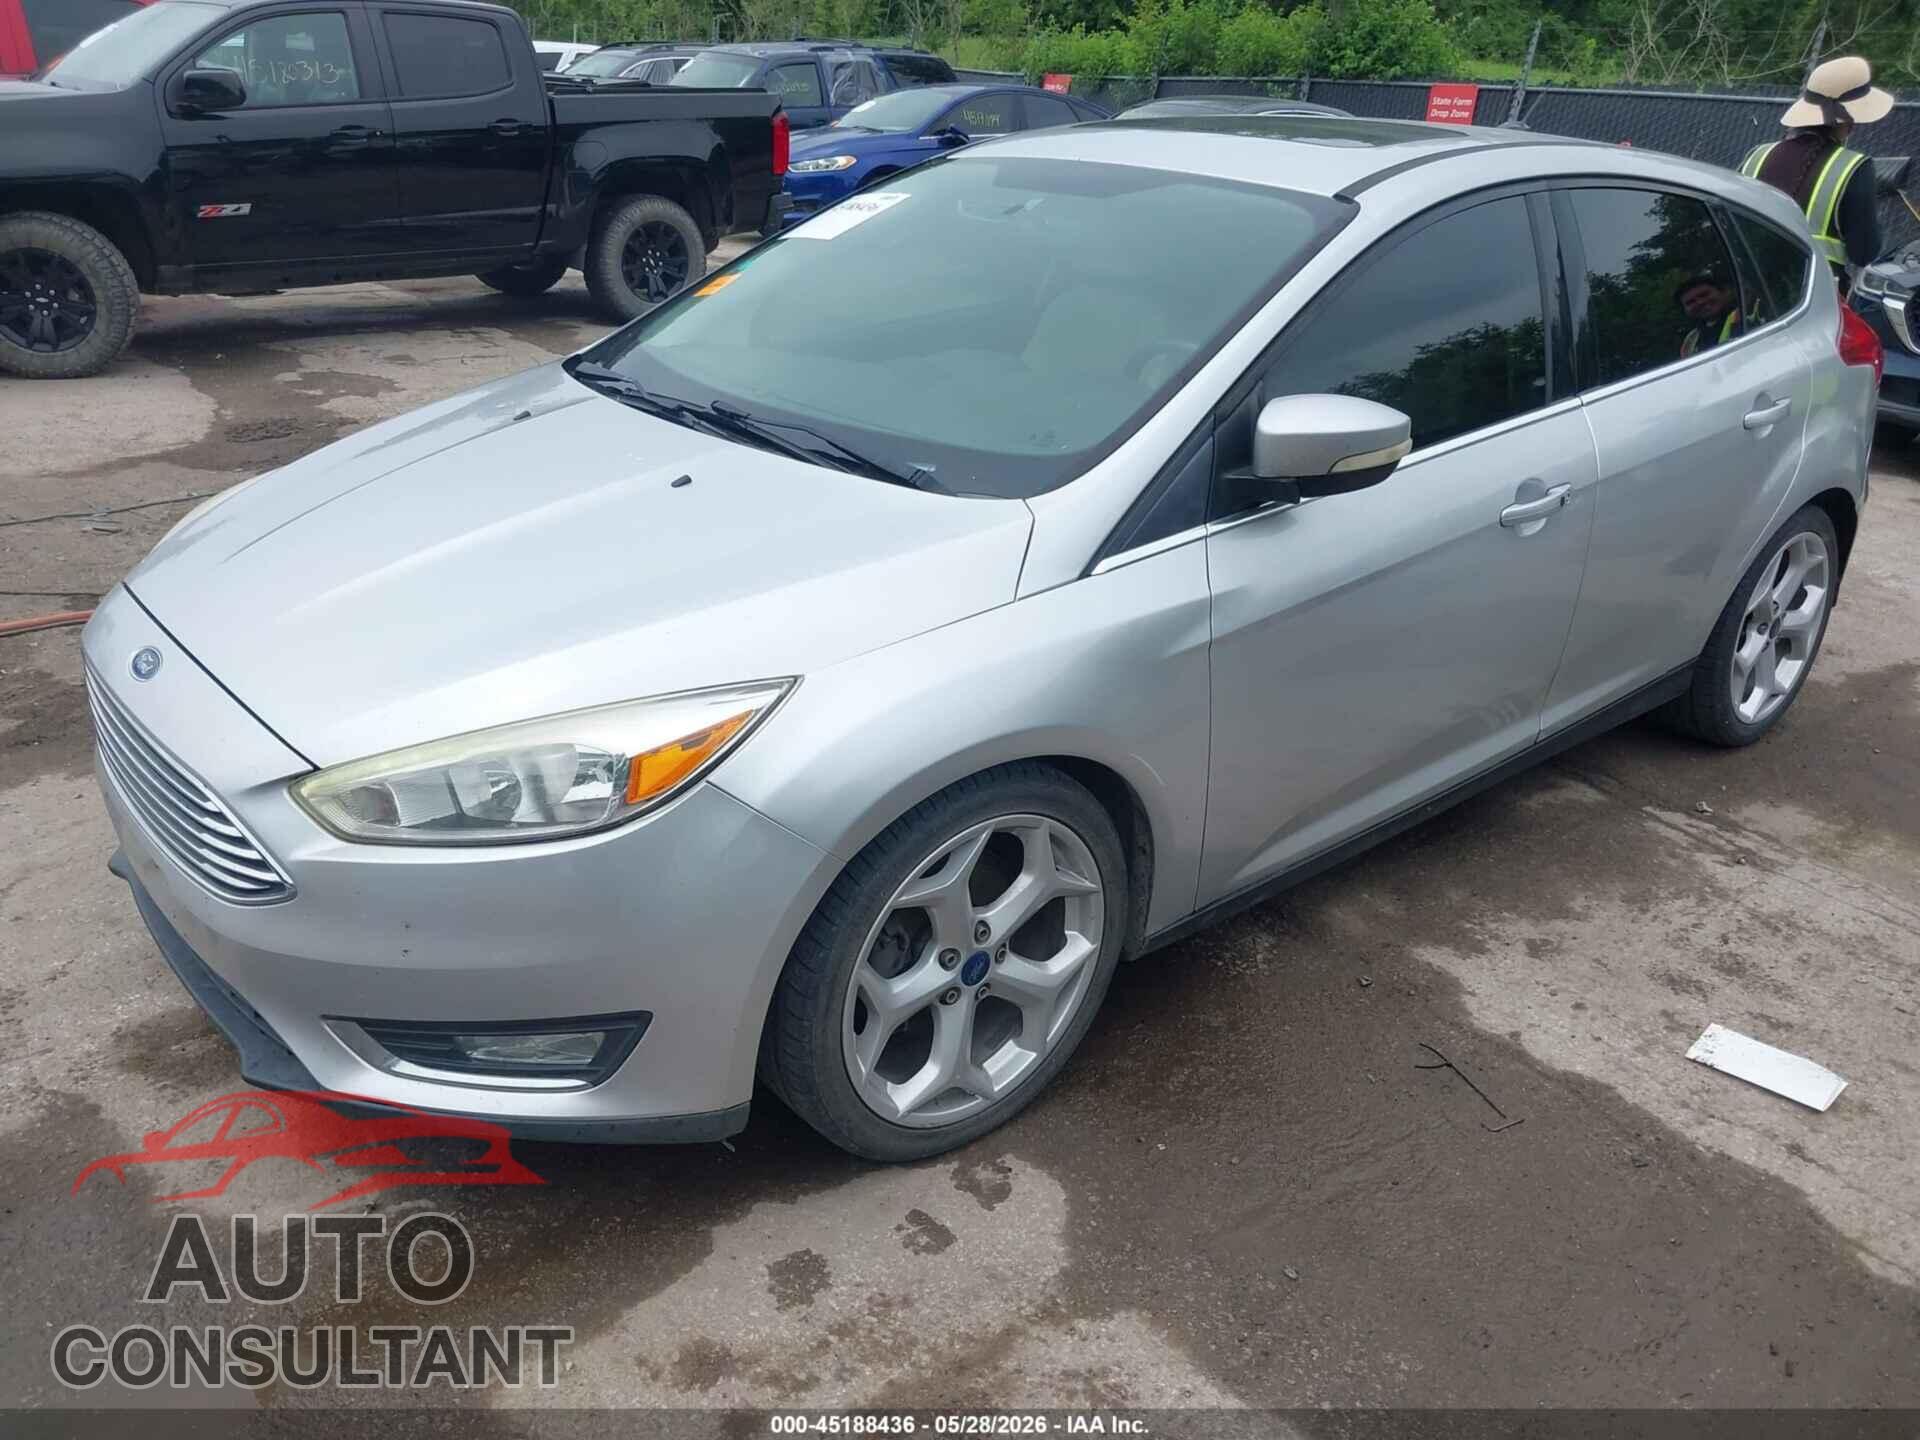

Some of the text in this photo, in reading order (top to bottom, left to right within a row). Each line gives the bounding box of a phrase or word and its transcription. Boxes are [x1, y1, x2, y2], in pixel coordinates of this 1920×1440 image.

[1432, 97, 1472, 106] State Farm
[1431, 109, 1470, 118] Drop Zone
